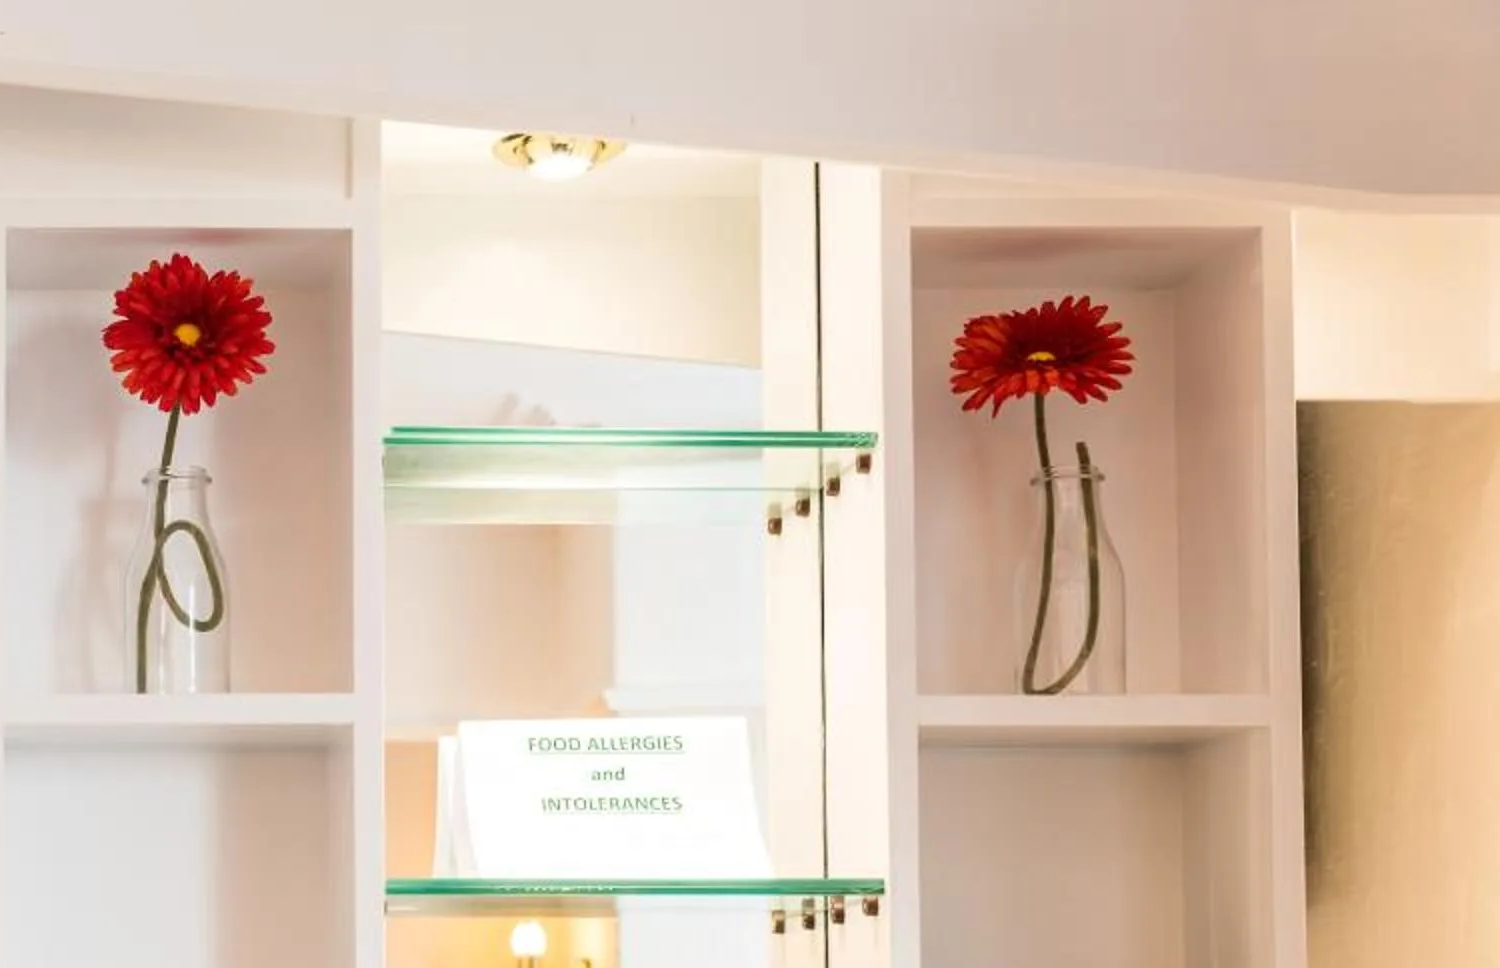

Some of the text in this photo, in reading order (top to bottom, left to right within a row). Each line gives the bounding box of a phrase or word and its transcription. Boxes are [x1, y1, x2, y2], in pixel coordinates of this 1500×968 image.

[528, 735, 684, 752] FOOD ALLERGIES
[591, 766, 626, 781] and
[541, 796, 684, 812] INTOLERANCES
